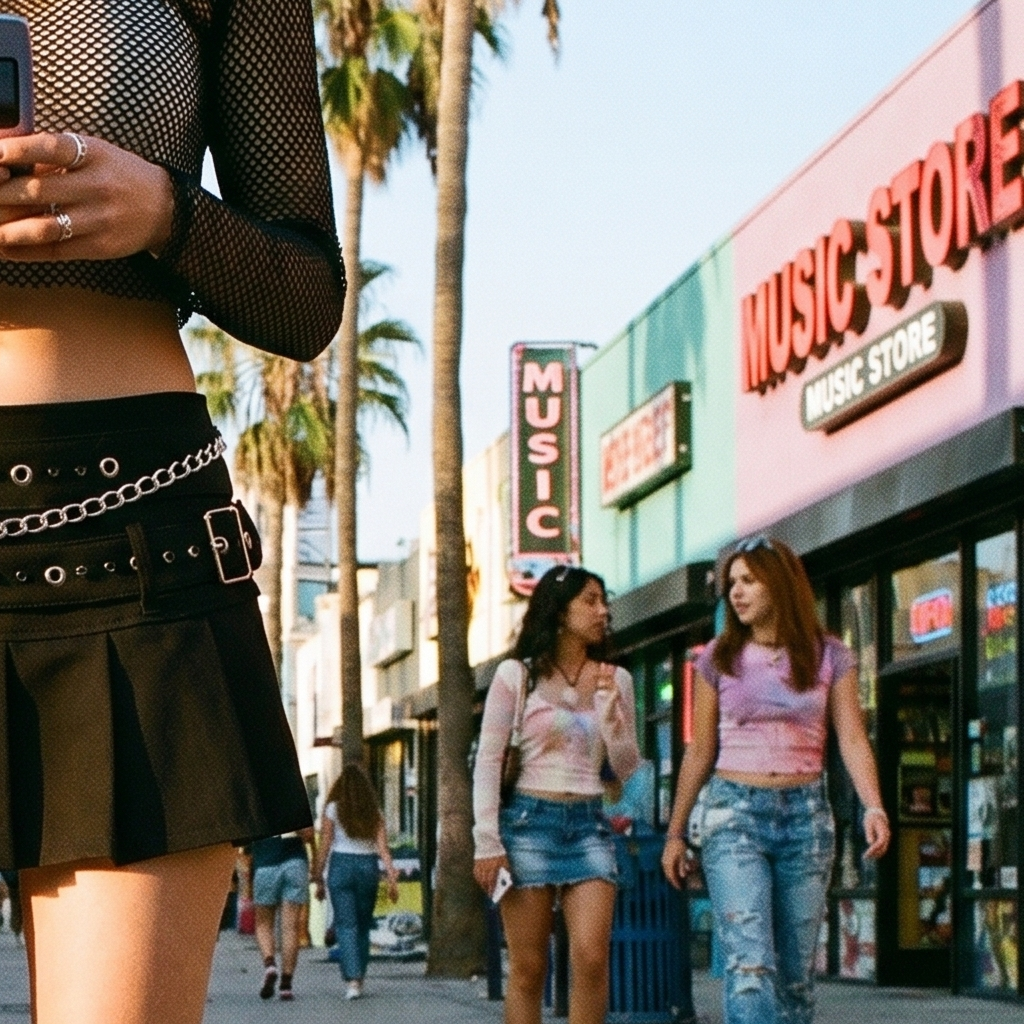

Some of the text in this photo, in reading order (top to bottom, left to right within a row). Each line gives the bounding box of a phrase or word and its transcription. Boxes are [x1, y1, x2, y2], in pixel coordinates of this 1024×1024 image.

[742, 79, 1022, 393] MUSIC STORE
[523, 361, 564, 538] MUSIC
[805, 311, 937, 422] MUSIC STORE
